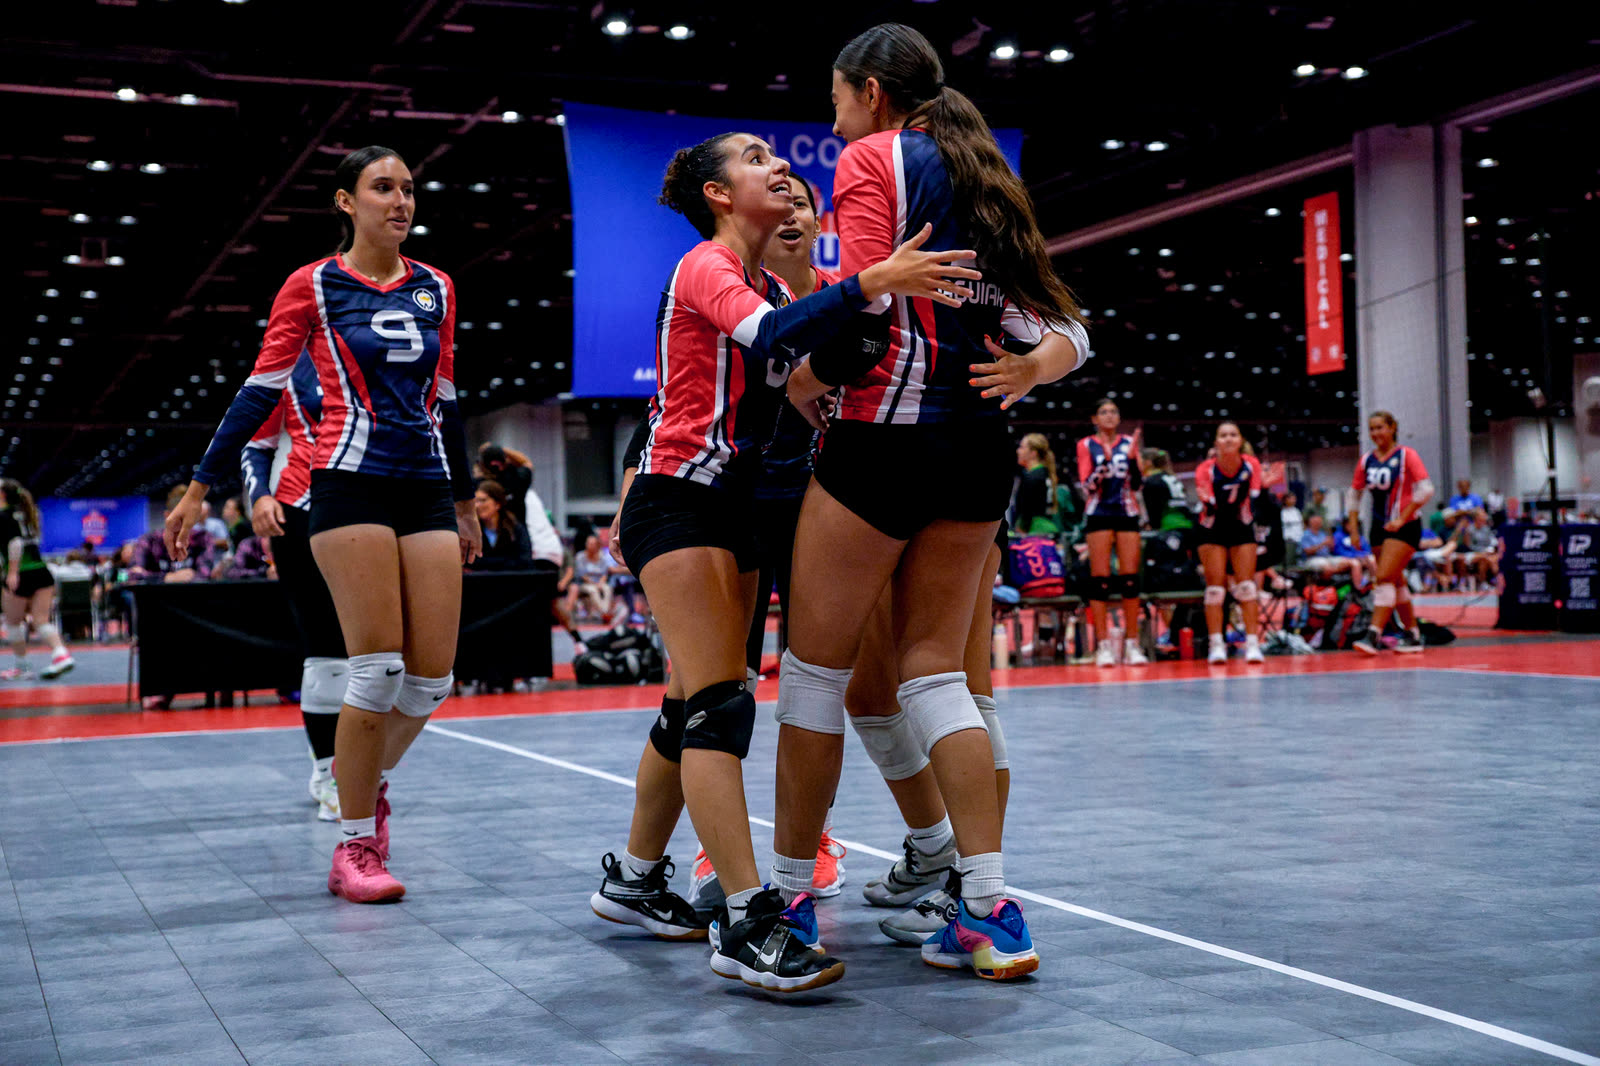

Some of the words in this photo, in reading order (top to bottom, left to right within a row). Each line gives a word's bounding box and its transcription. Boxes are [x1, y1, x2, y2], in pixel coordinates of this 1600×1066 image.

[1313, 209, 1330, 329] MEDICAL
[370, 310, 425, 362] 9
[1222, 484, 1239, 503] 7
